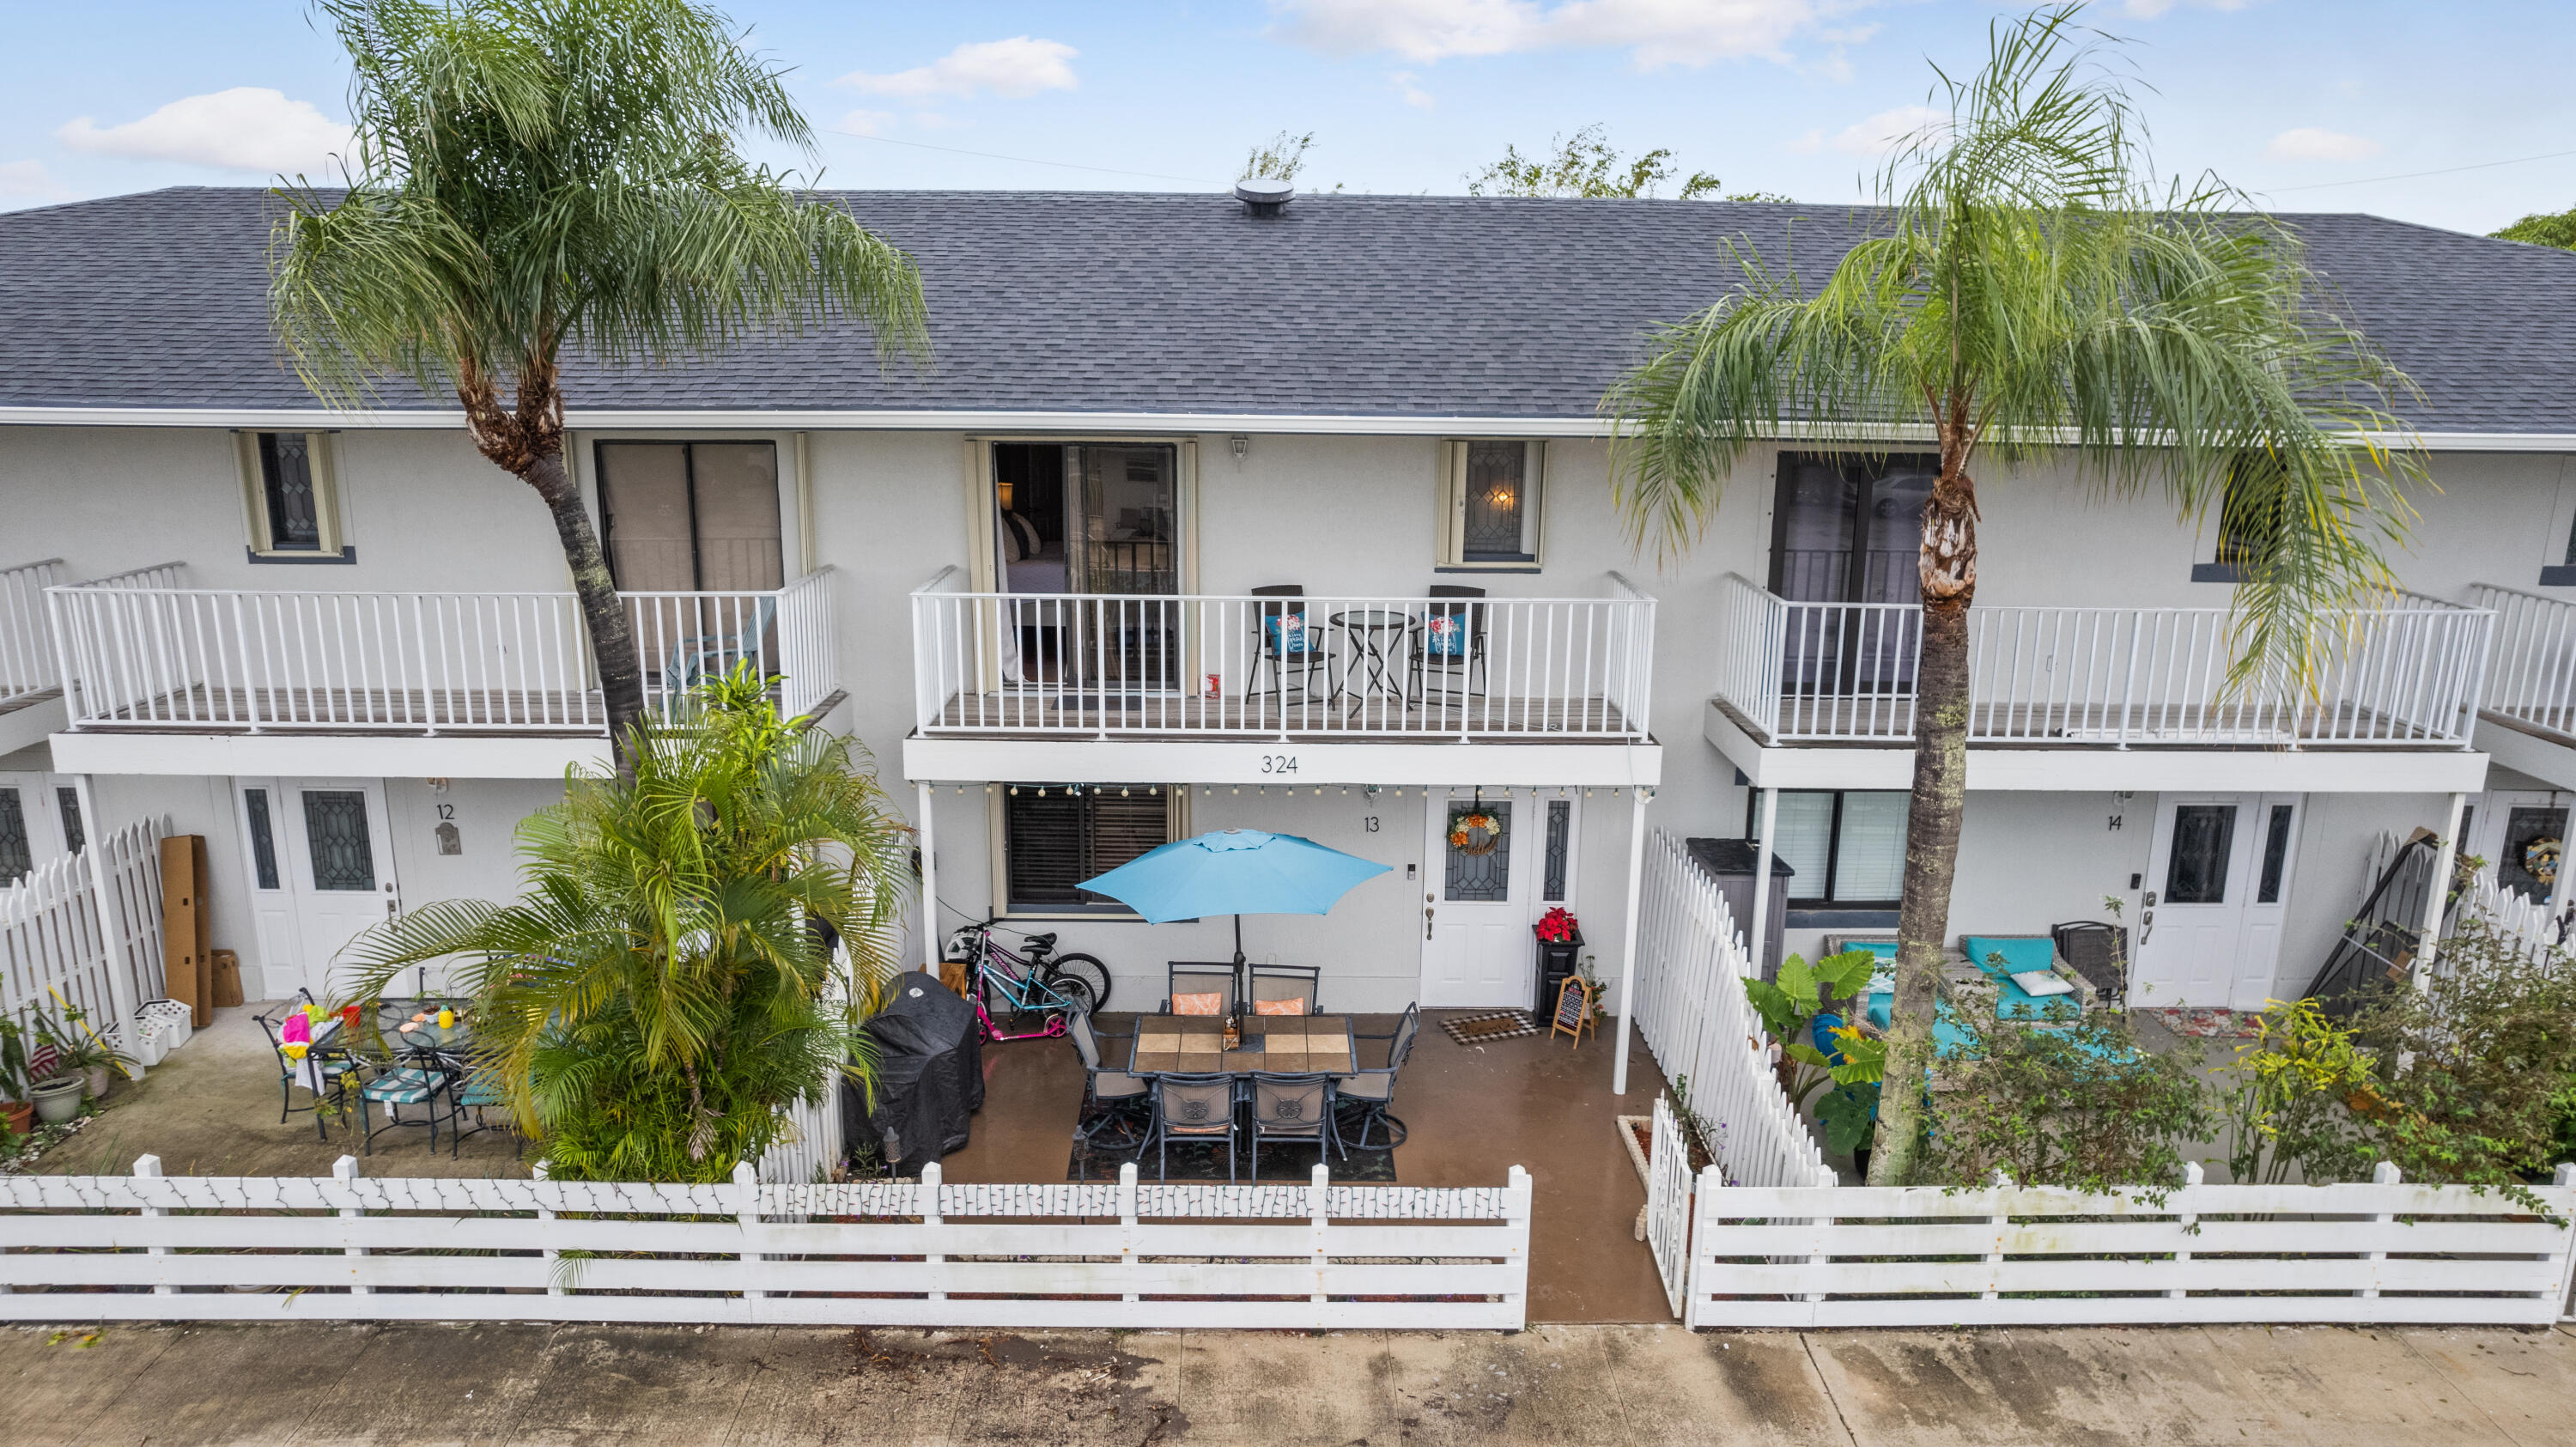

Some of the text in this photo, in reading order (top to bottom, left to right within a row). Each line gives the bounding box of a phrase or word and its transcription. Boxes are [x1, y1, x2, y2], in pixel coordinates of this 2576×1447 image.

[1261, 756, 1298, 774] 324
[436, 804, 455, 820] 12
[1364, 816, 1380, 833] 13
[2108, 815, 2123, 831] 14
